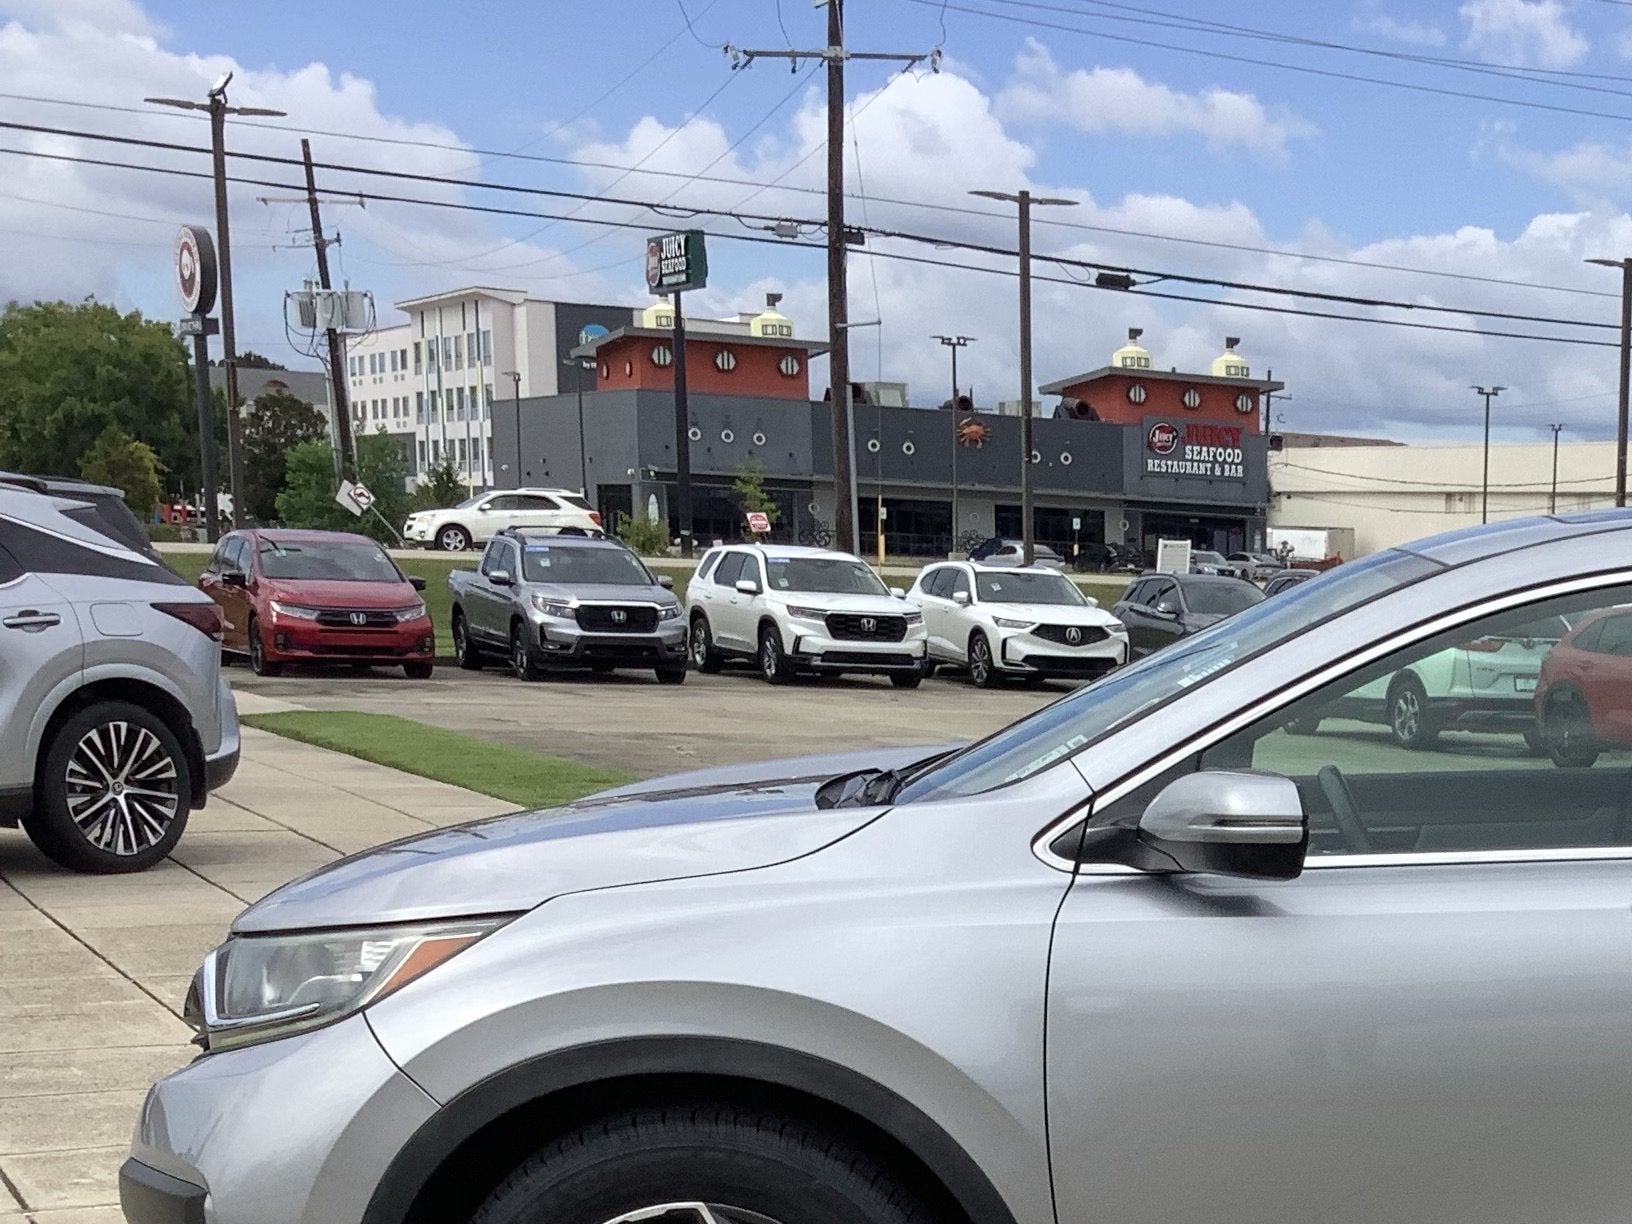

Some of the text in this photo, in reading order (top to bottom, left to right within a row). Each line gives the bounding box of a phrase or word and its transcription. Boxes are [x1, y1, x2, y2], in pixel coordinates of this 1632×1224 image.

[661, 234, 687, 260] JUICY
[661, 256, 687, 274] SEAFOOD
[1185, 445, 1243, 463] SEAFOOD
[1147, 459, 1244, 478] RESTAURANT & BAR
